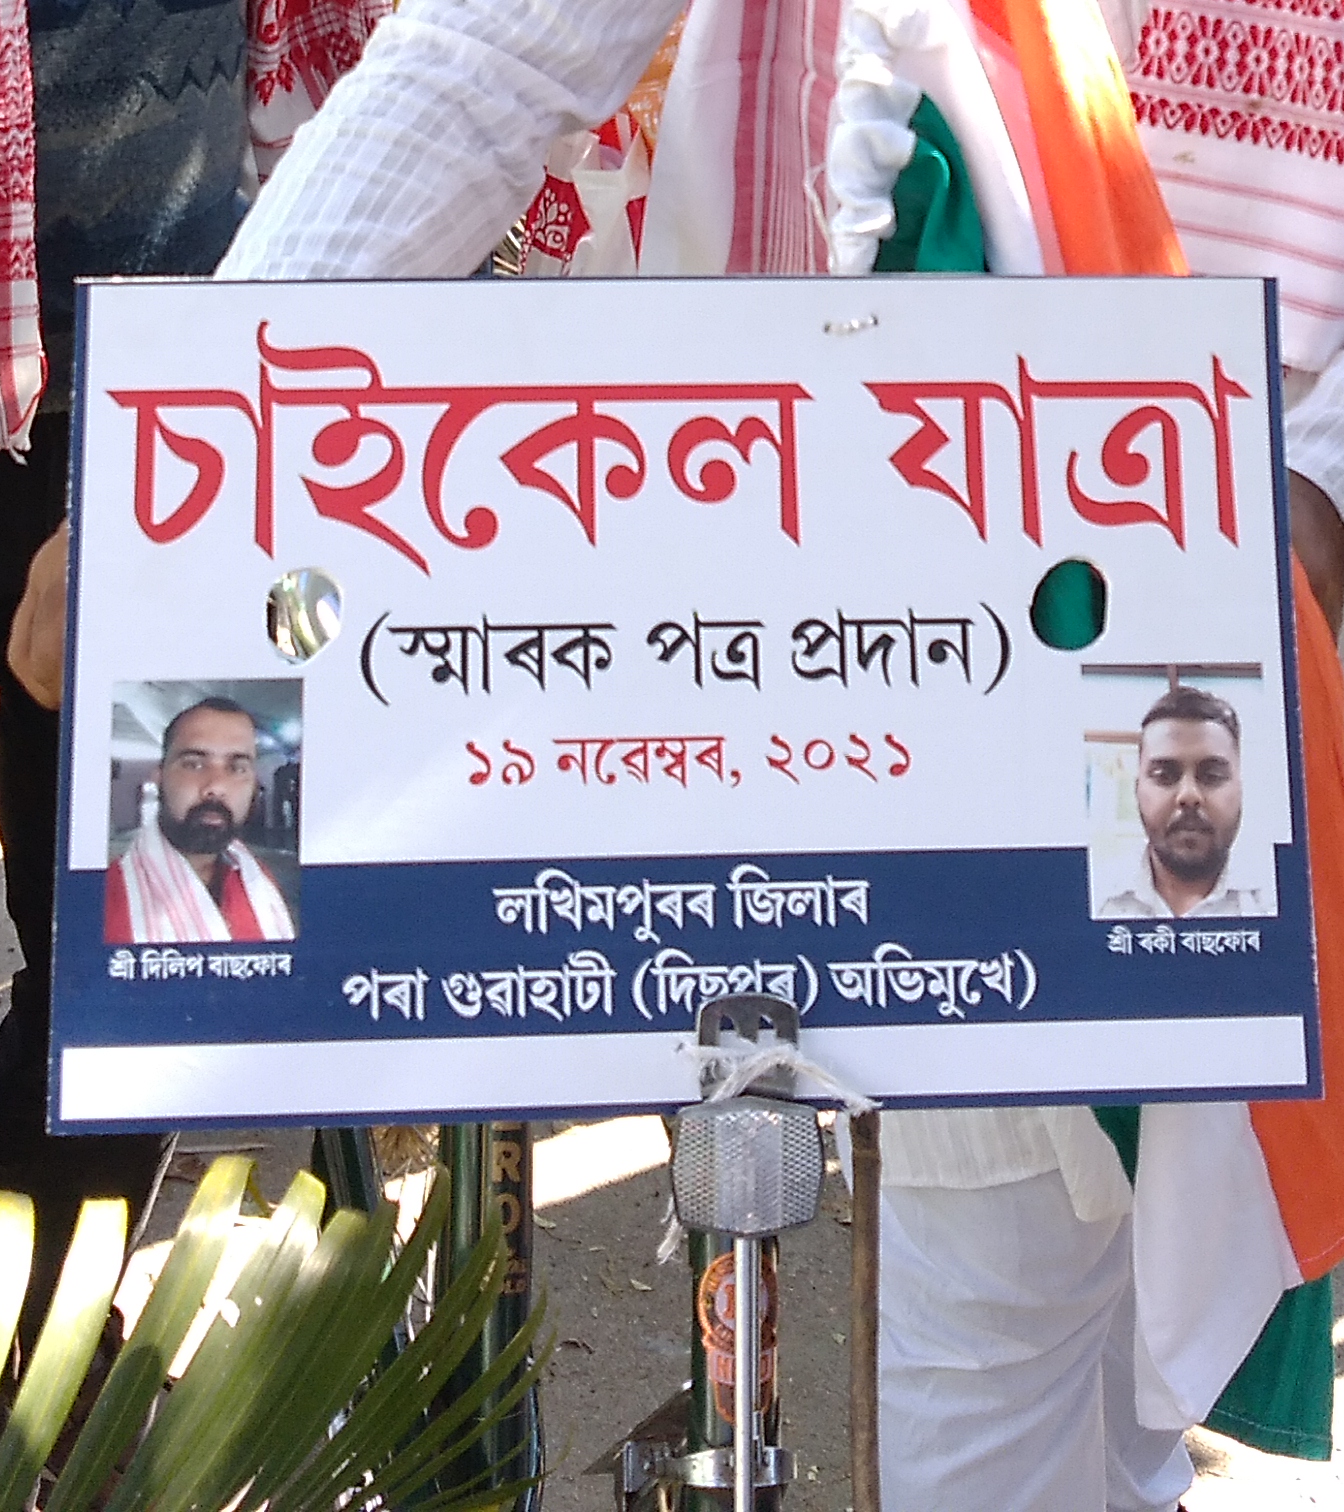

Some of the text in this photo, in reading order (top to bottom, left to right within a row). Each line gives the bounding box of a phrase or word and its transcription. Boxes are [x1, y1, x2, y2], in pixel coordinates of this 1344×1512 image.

[106, 320, 814, 576] চাইকেল
[464, 739, 537, 786] ১৯
[765, 732, 914, 784] ২০২১
[725, 862, 872, 930] জিলাৰ
[140, 948, 205, 980] দিলিপ
[341, 967, 431, 1022] পৰা
[825, 941, 1038, 1021] অভিমুখে)
